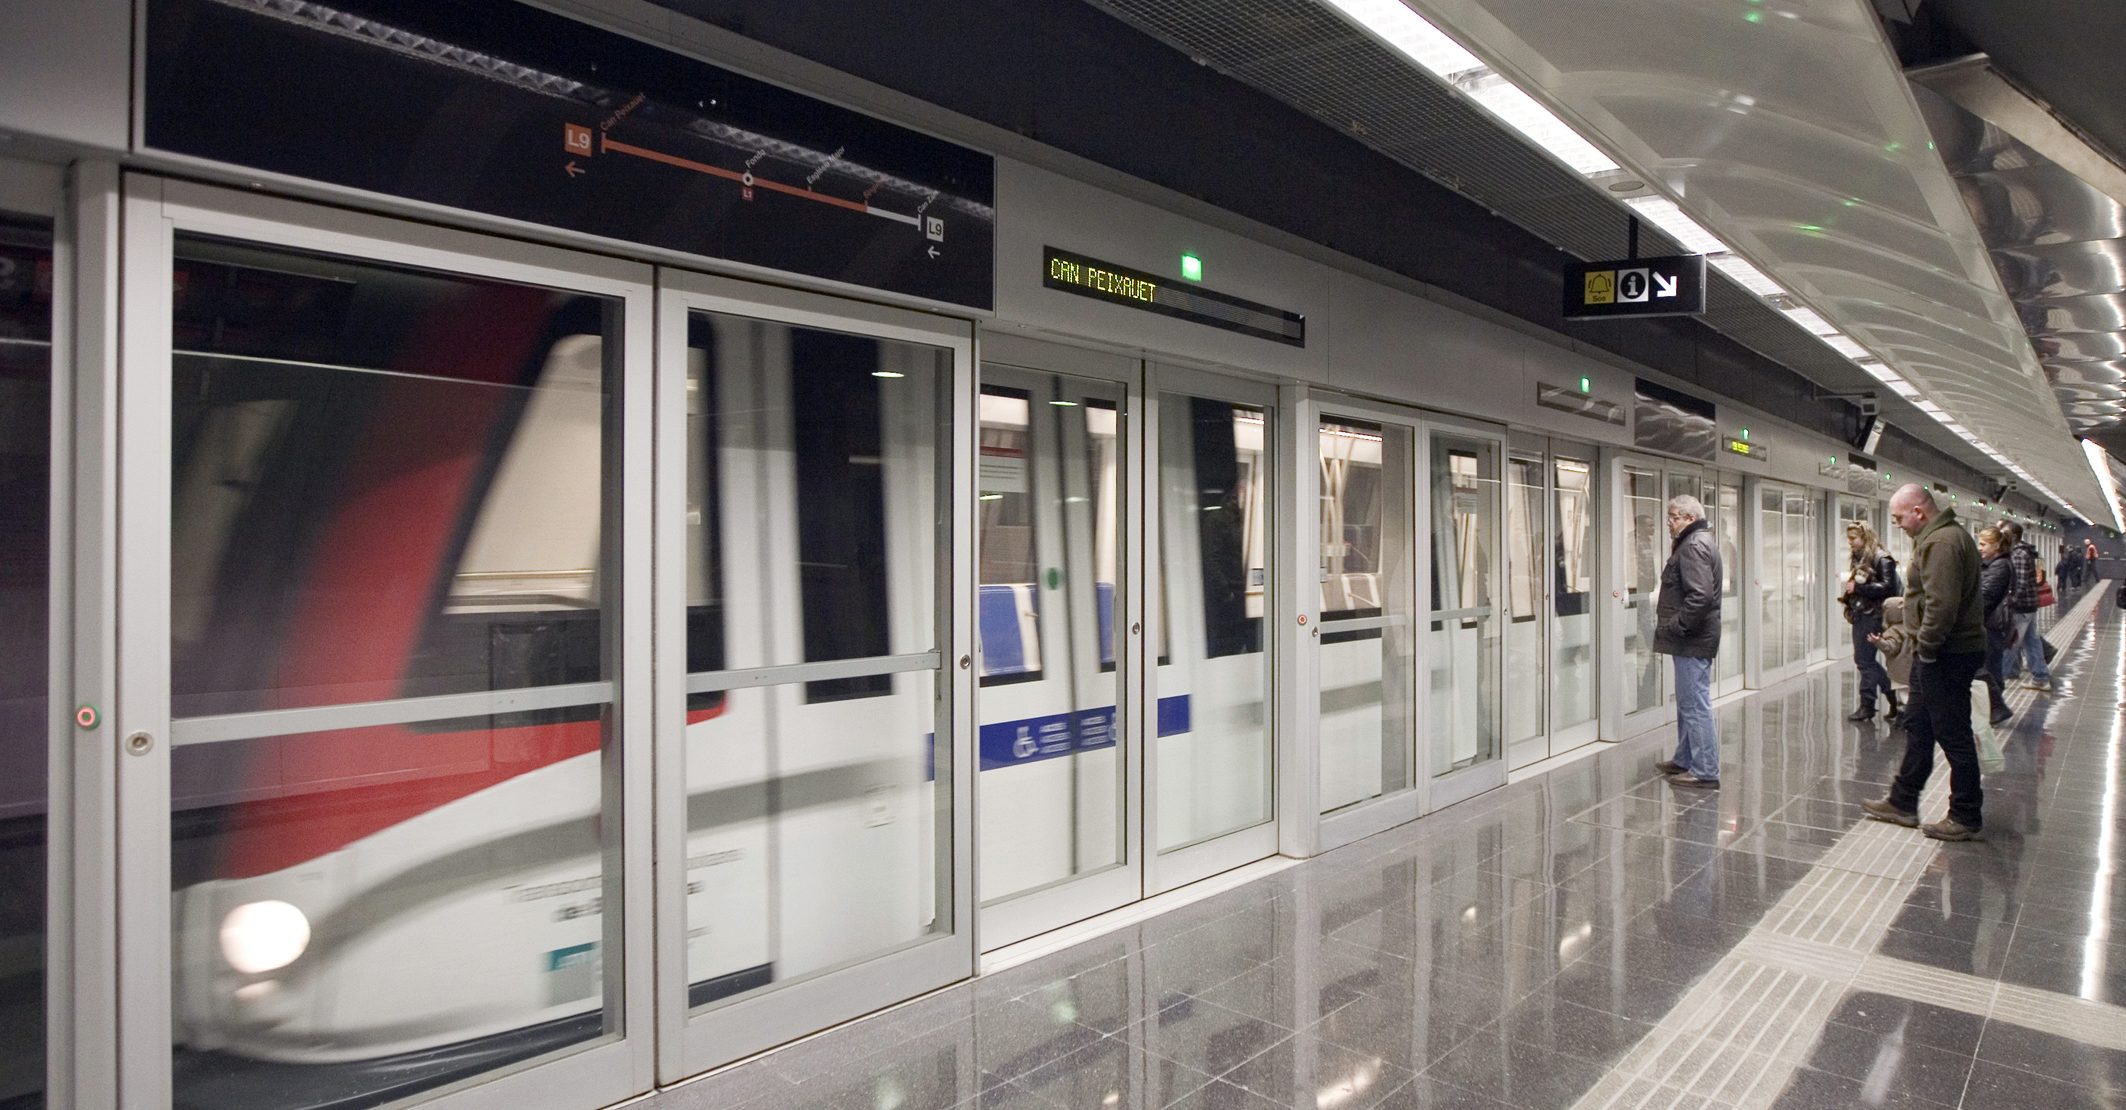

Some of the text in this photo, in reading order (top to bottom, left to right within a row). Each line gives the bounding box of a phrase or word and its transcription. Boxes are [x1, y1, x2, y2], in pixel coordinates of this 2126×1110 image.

[568, 129, 591, 150] L9
[928, 221, 942, 235] L9
[1051, 258, 1156, 302] CAN PEIXAUET
